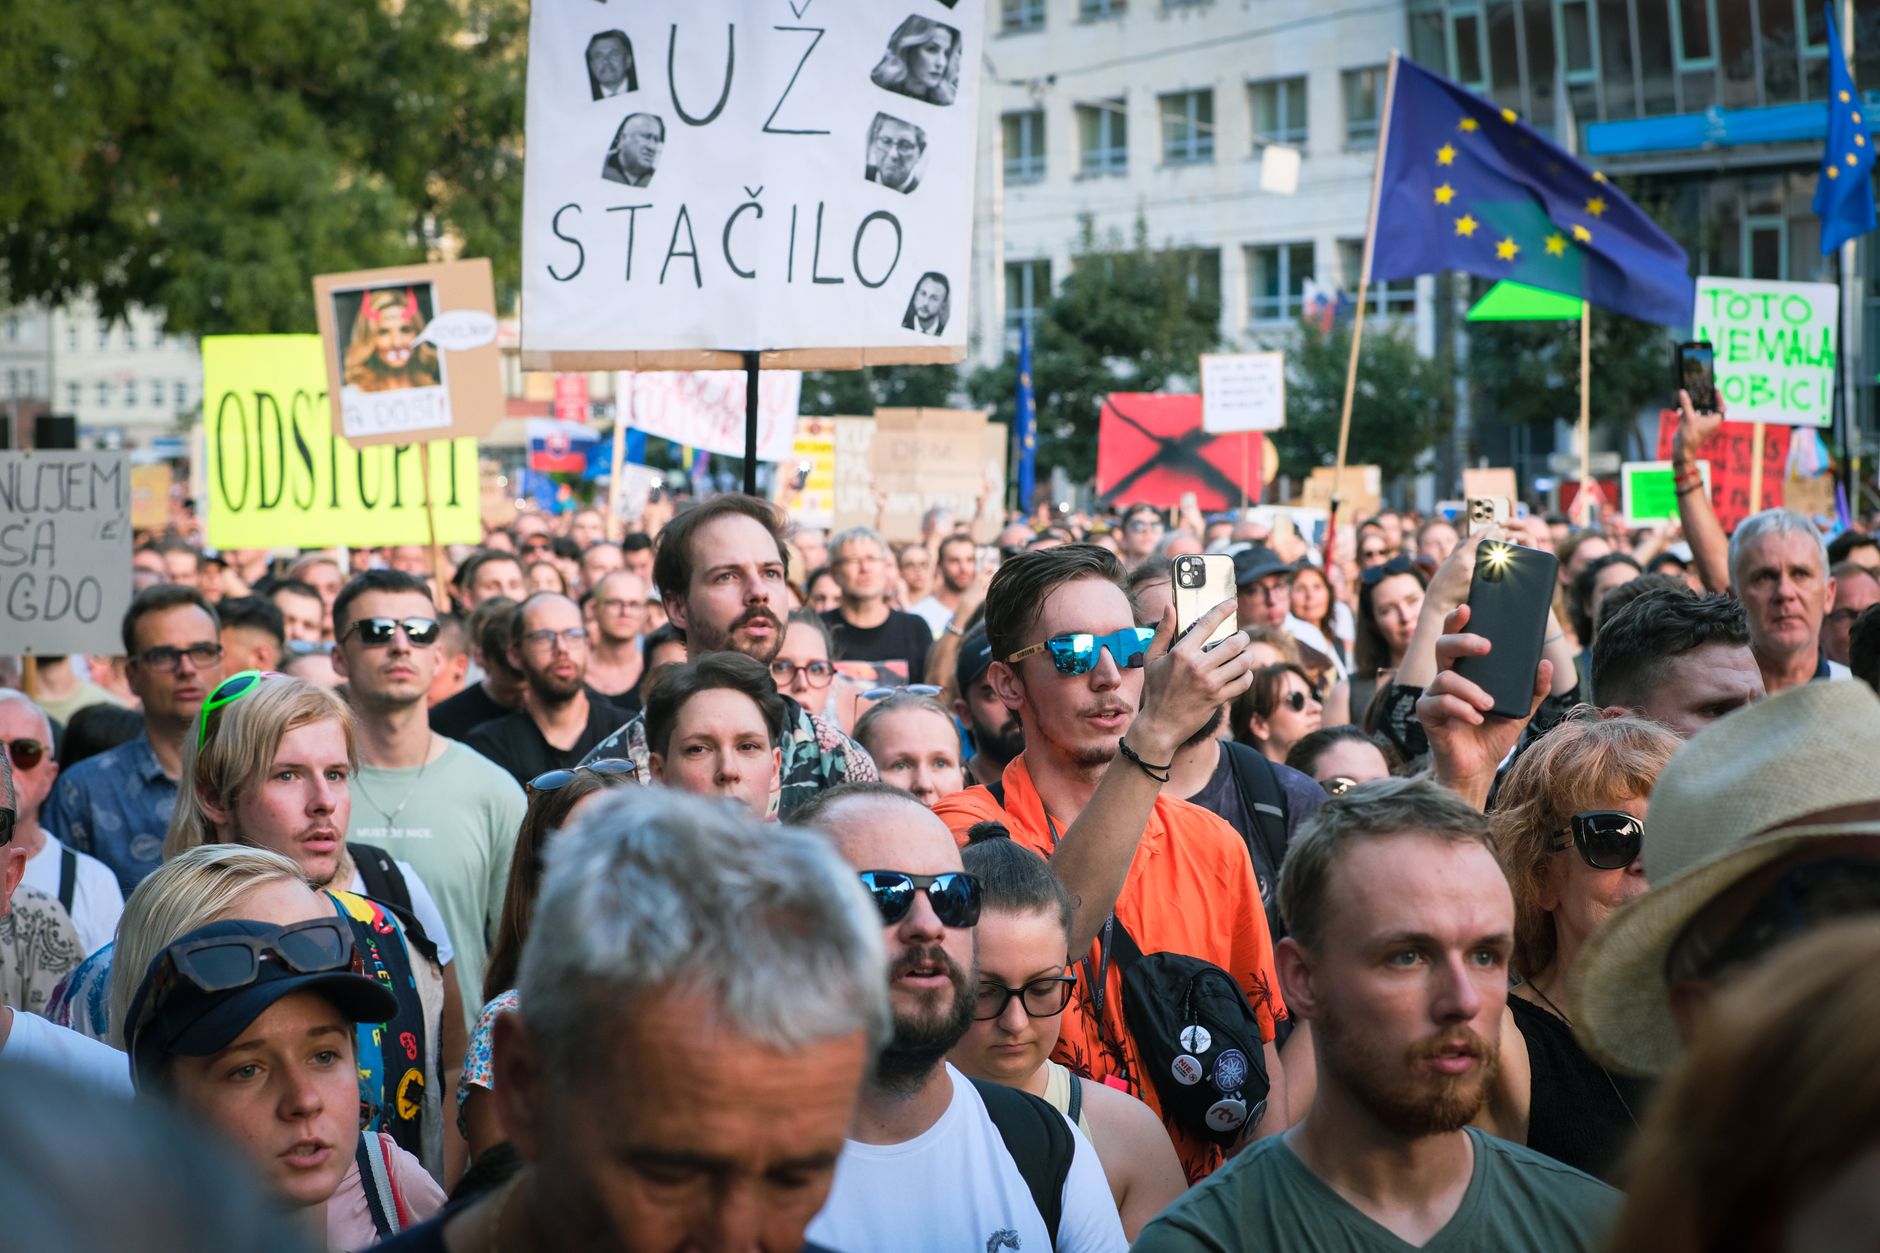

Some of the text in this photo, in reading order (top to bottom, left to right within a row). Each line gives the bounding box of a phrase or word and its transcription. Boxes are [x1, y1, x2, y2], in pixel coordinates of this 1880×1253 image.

[667, 0, 831, 135] UŽ
[547, 185, 902, 289] STAČILO
[1701, 287, 1813, 325] TOTO
[1714, 374, 1829, 421] OBIC!
